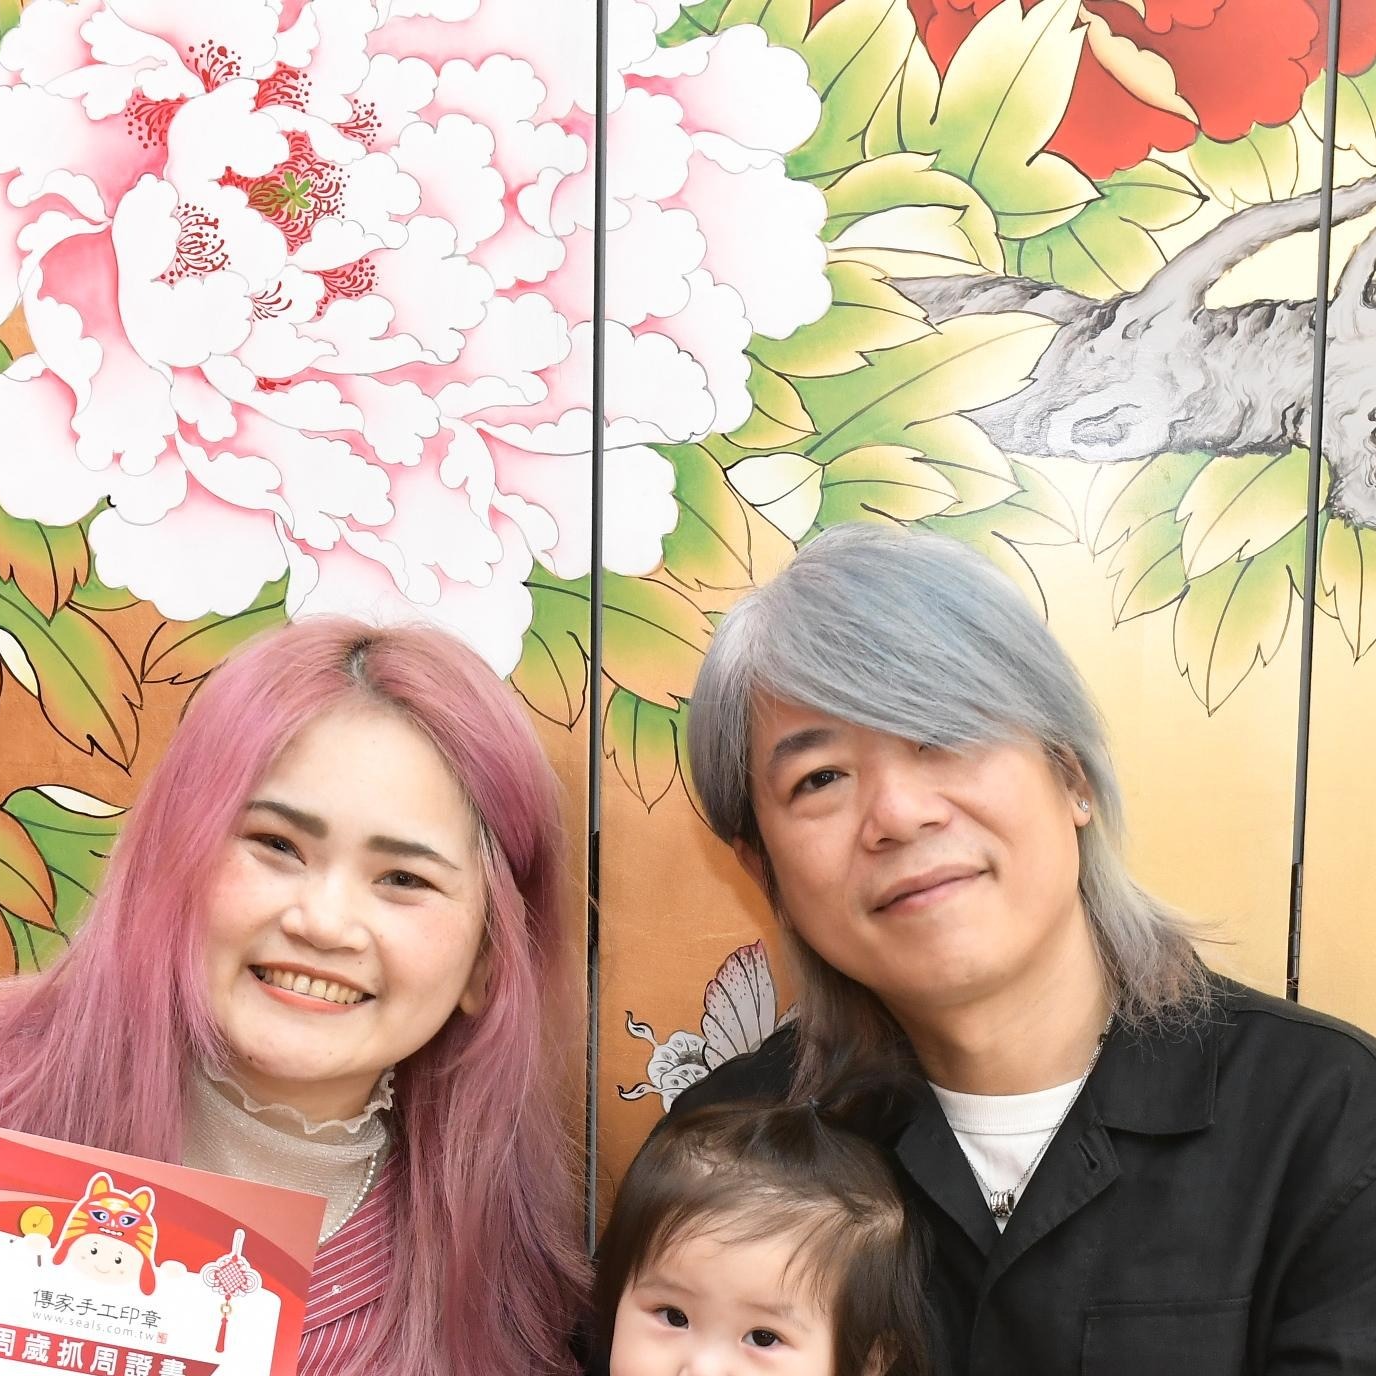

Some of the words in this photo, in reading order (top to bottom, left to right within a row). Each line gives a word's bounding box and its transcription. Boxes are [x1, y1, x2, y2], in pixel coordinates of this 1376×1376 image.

[33, 1288, 162, 1328] 傳家手工印章
[31, 1311, 155, 1341] www.seals.com.tw
